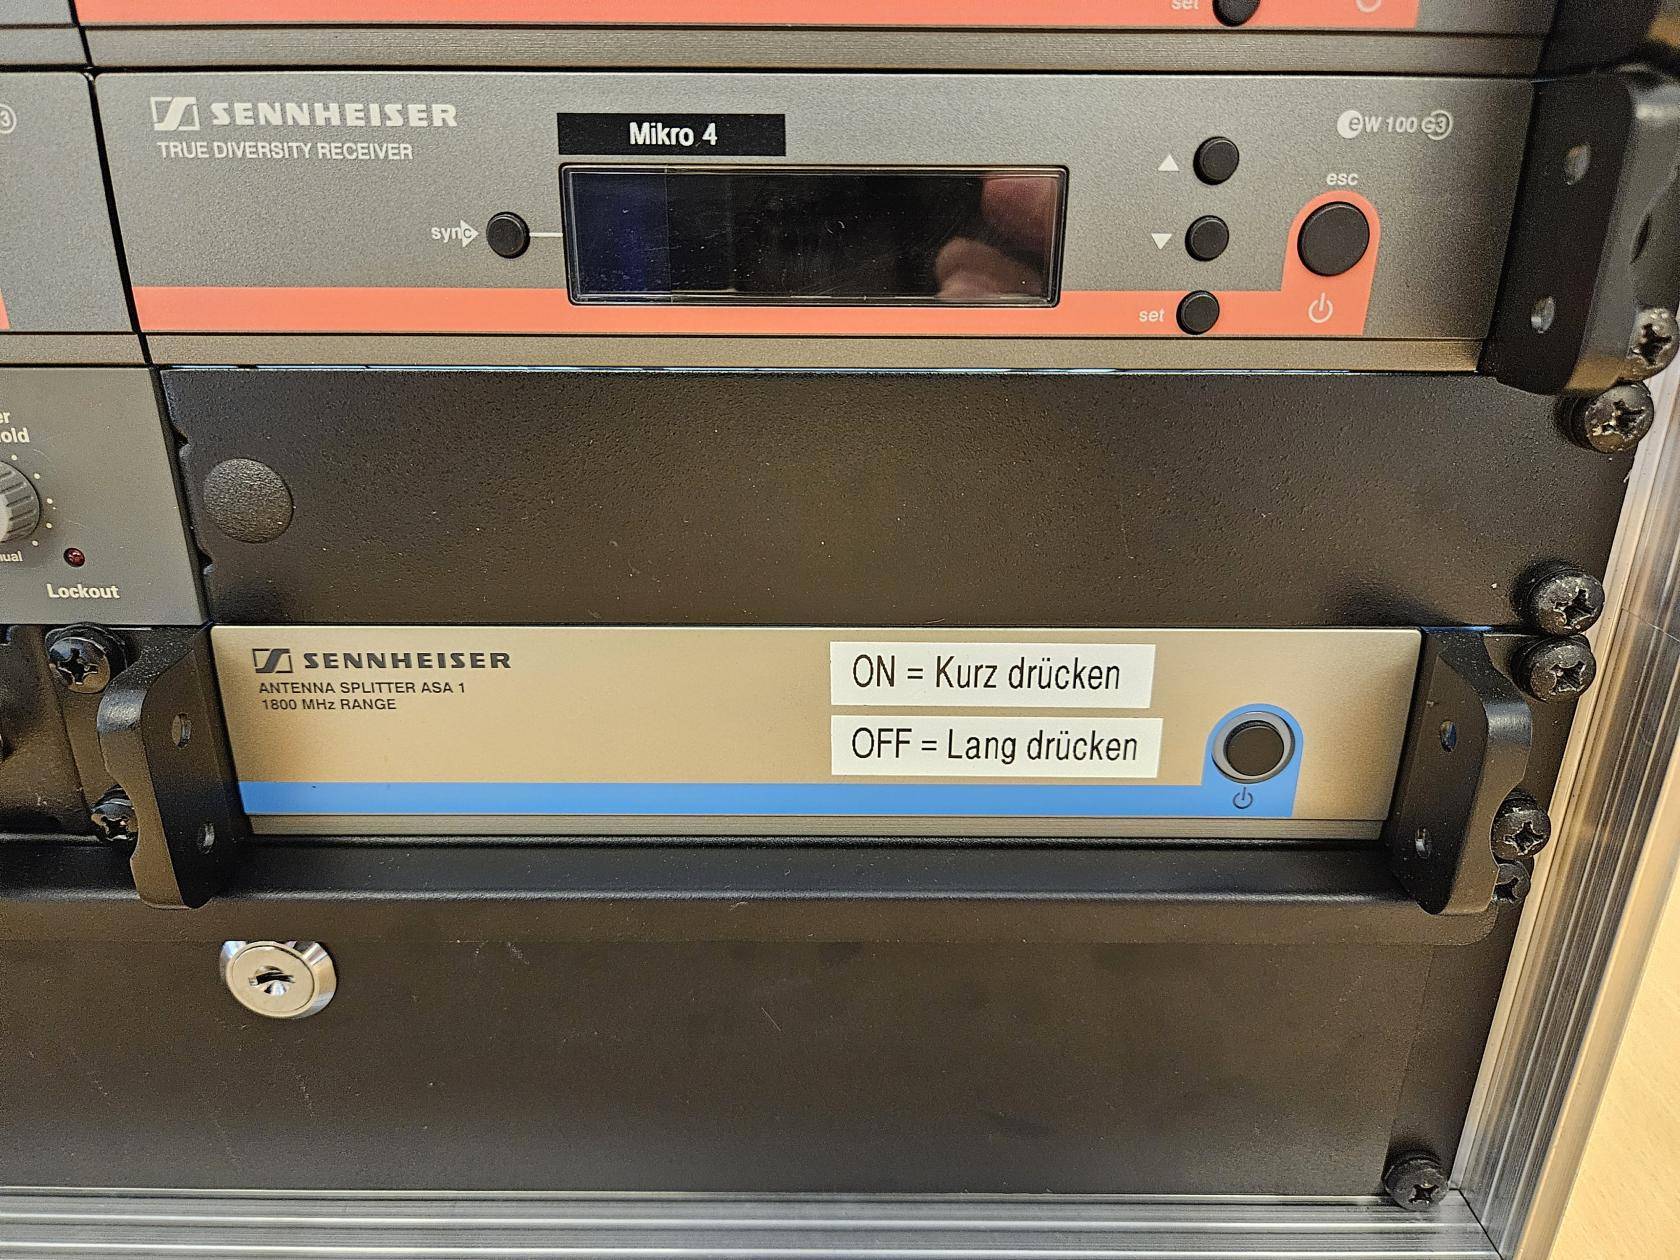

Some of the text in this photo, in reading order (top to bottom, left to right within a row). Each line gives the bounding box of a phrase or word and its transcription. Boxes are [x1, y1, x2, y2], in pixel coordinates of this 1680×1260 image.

[210, 102, 458, 128] SENNHEISER
[1385, 116, 1418, 133] 100
[1420, 111, 1453, 138] G3
[629, 121, 718, 147] Mikro 4
[157, 141, 414, 161] TRUE DIVERSITY RECEIVER
[1325, 172, 1359, 186] esc
[430, 226, 475, 245] sync
[1138, 308, 1166, 323] set
[0, 427, 30, 443] old
[46, 583, 121, 599] Lockout
[303, 652, 512, 670] SENNHEISER
[852, 653, 1121, 690] ON = Kurz drücken
[258, 681, 465, 694] ANTENNA SPLITTER ASA 1
[261, 698, 397, 710] 1800 MHz RANGE
[851, 726, 1138, 766] OFF = Lang drücken
